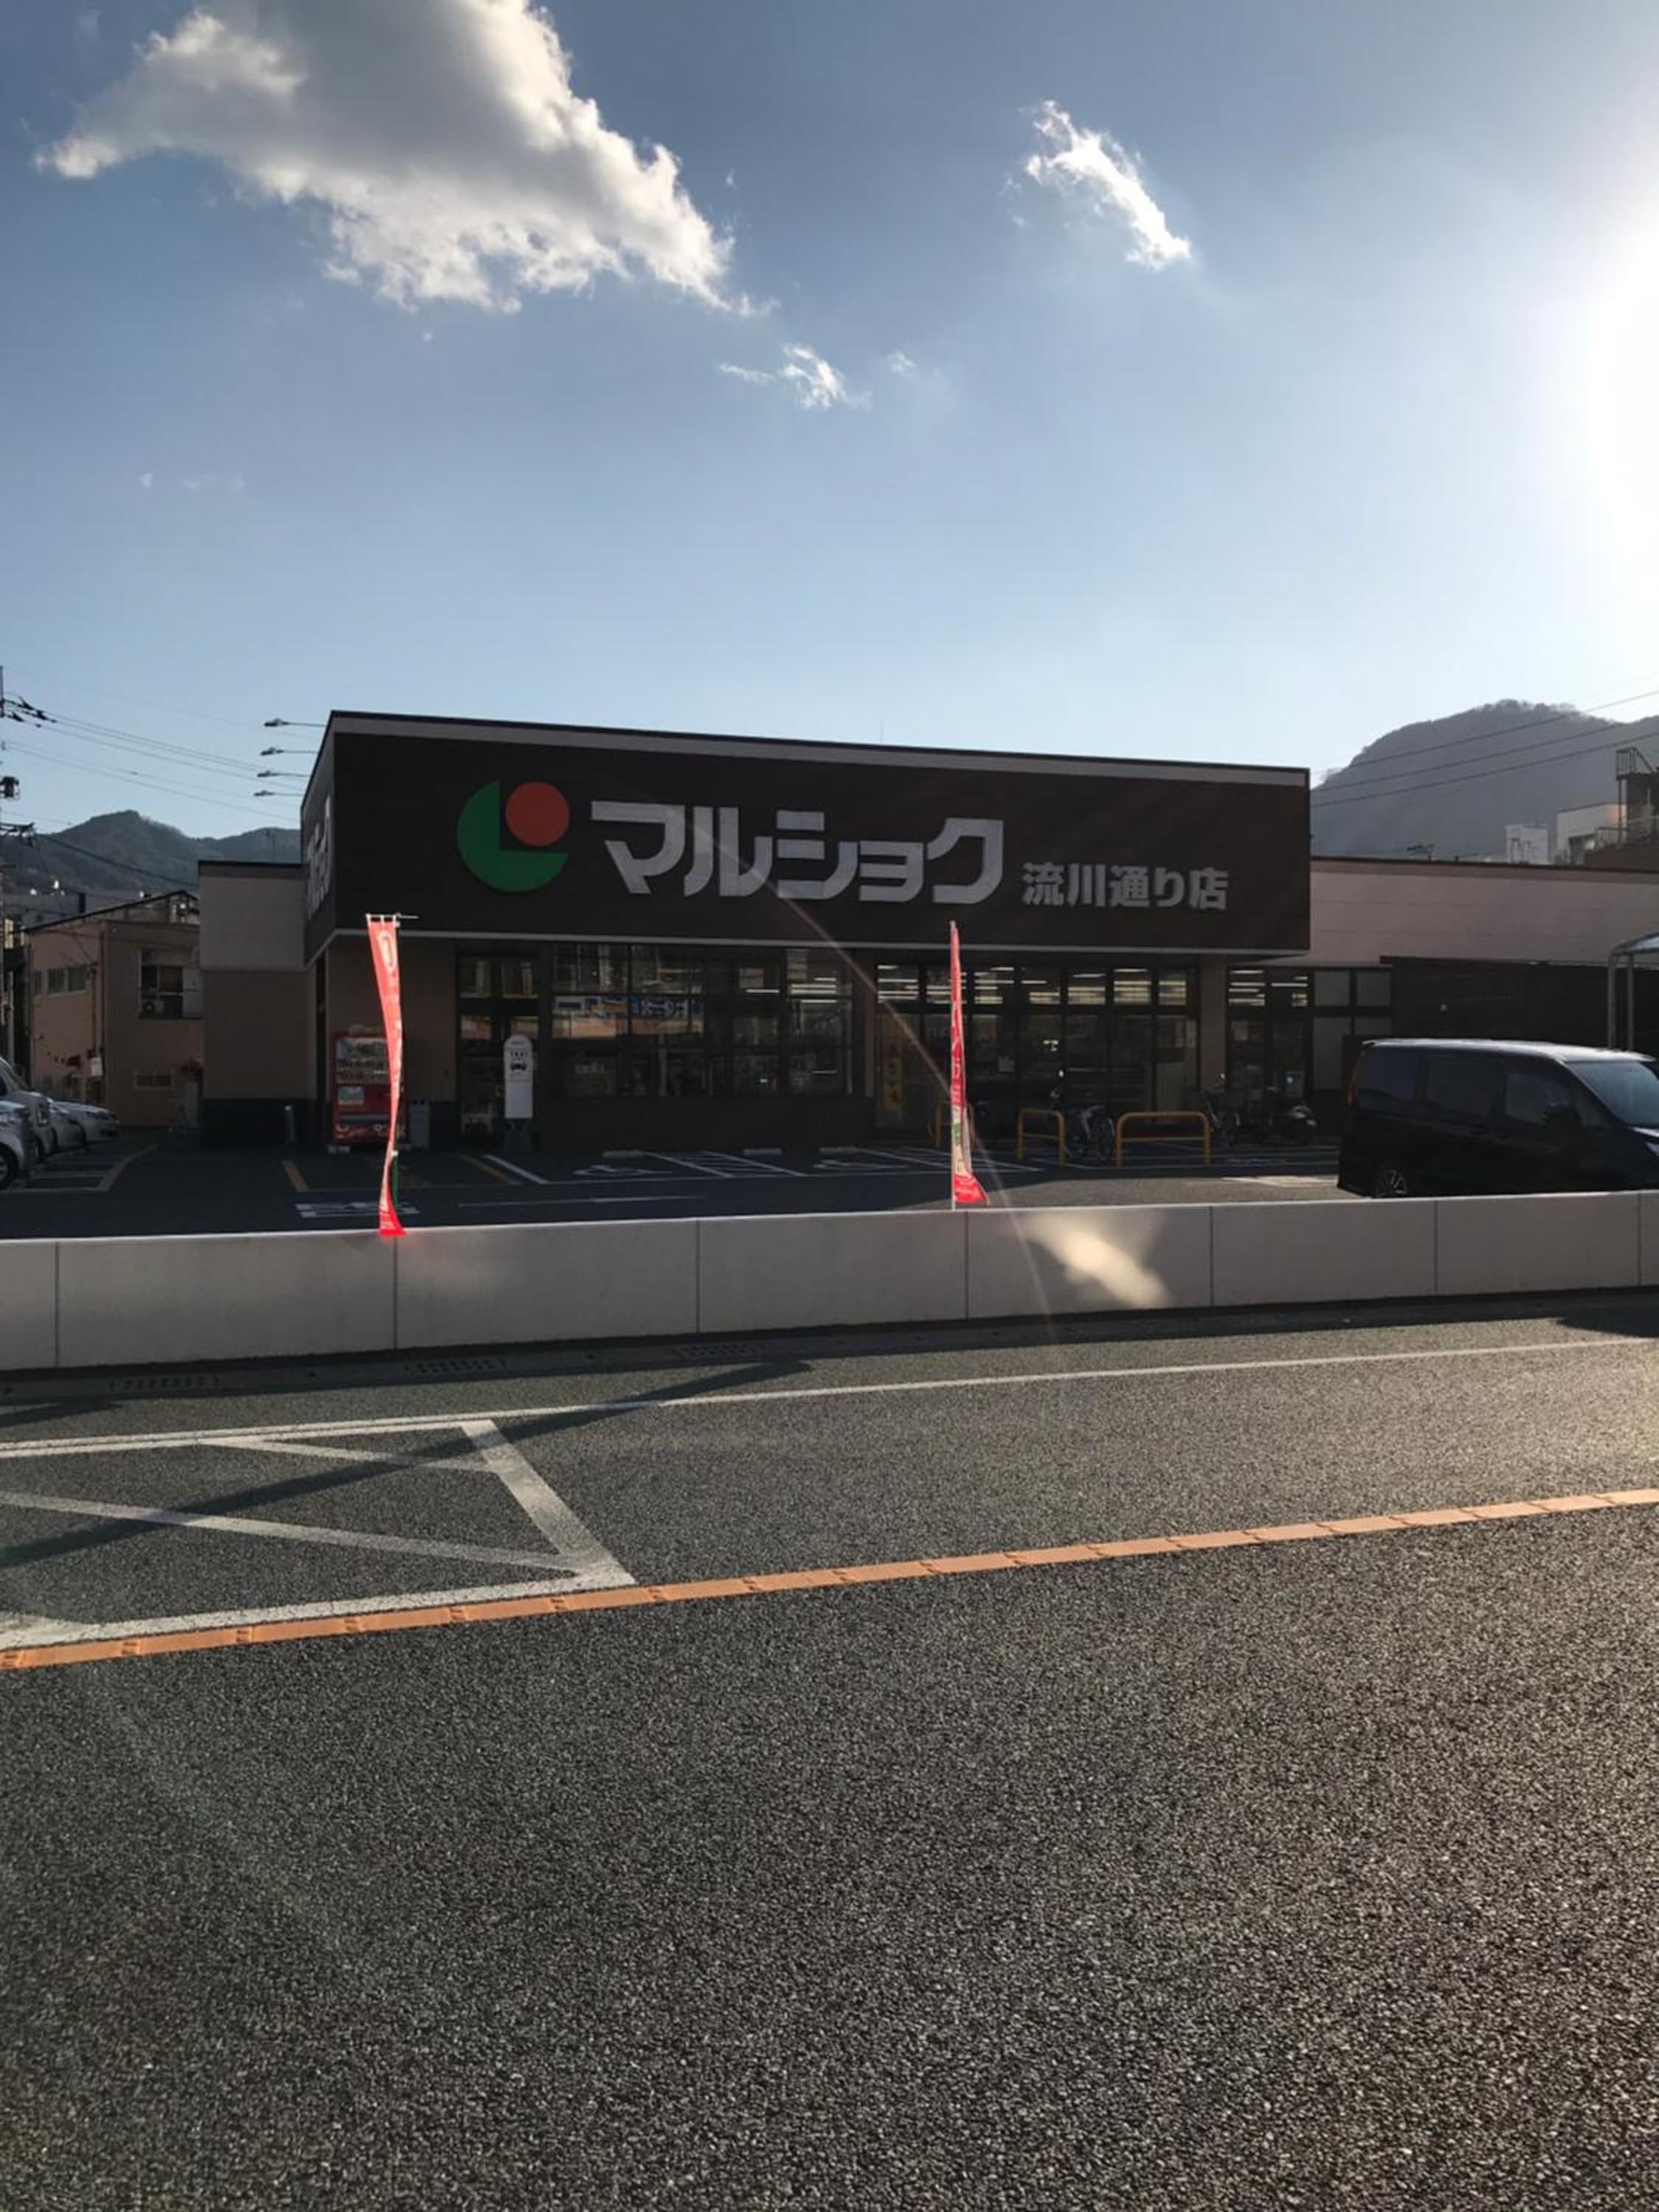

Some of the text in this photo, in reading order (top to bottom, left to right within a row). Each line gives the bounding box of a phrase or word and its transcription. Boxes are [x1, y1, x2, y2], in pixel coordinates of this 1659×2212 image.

[591, 800, 1004, 905] マルショク
[1021, 861, 1229, 910] 流川通り店
